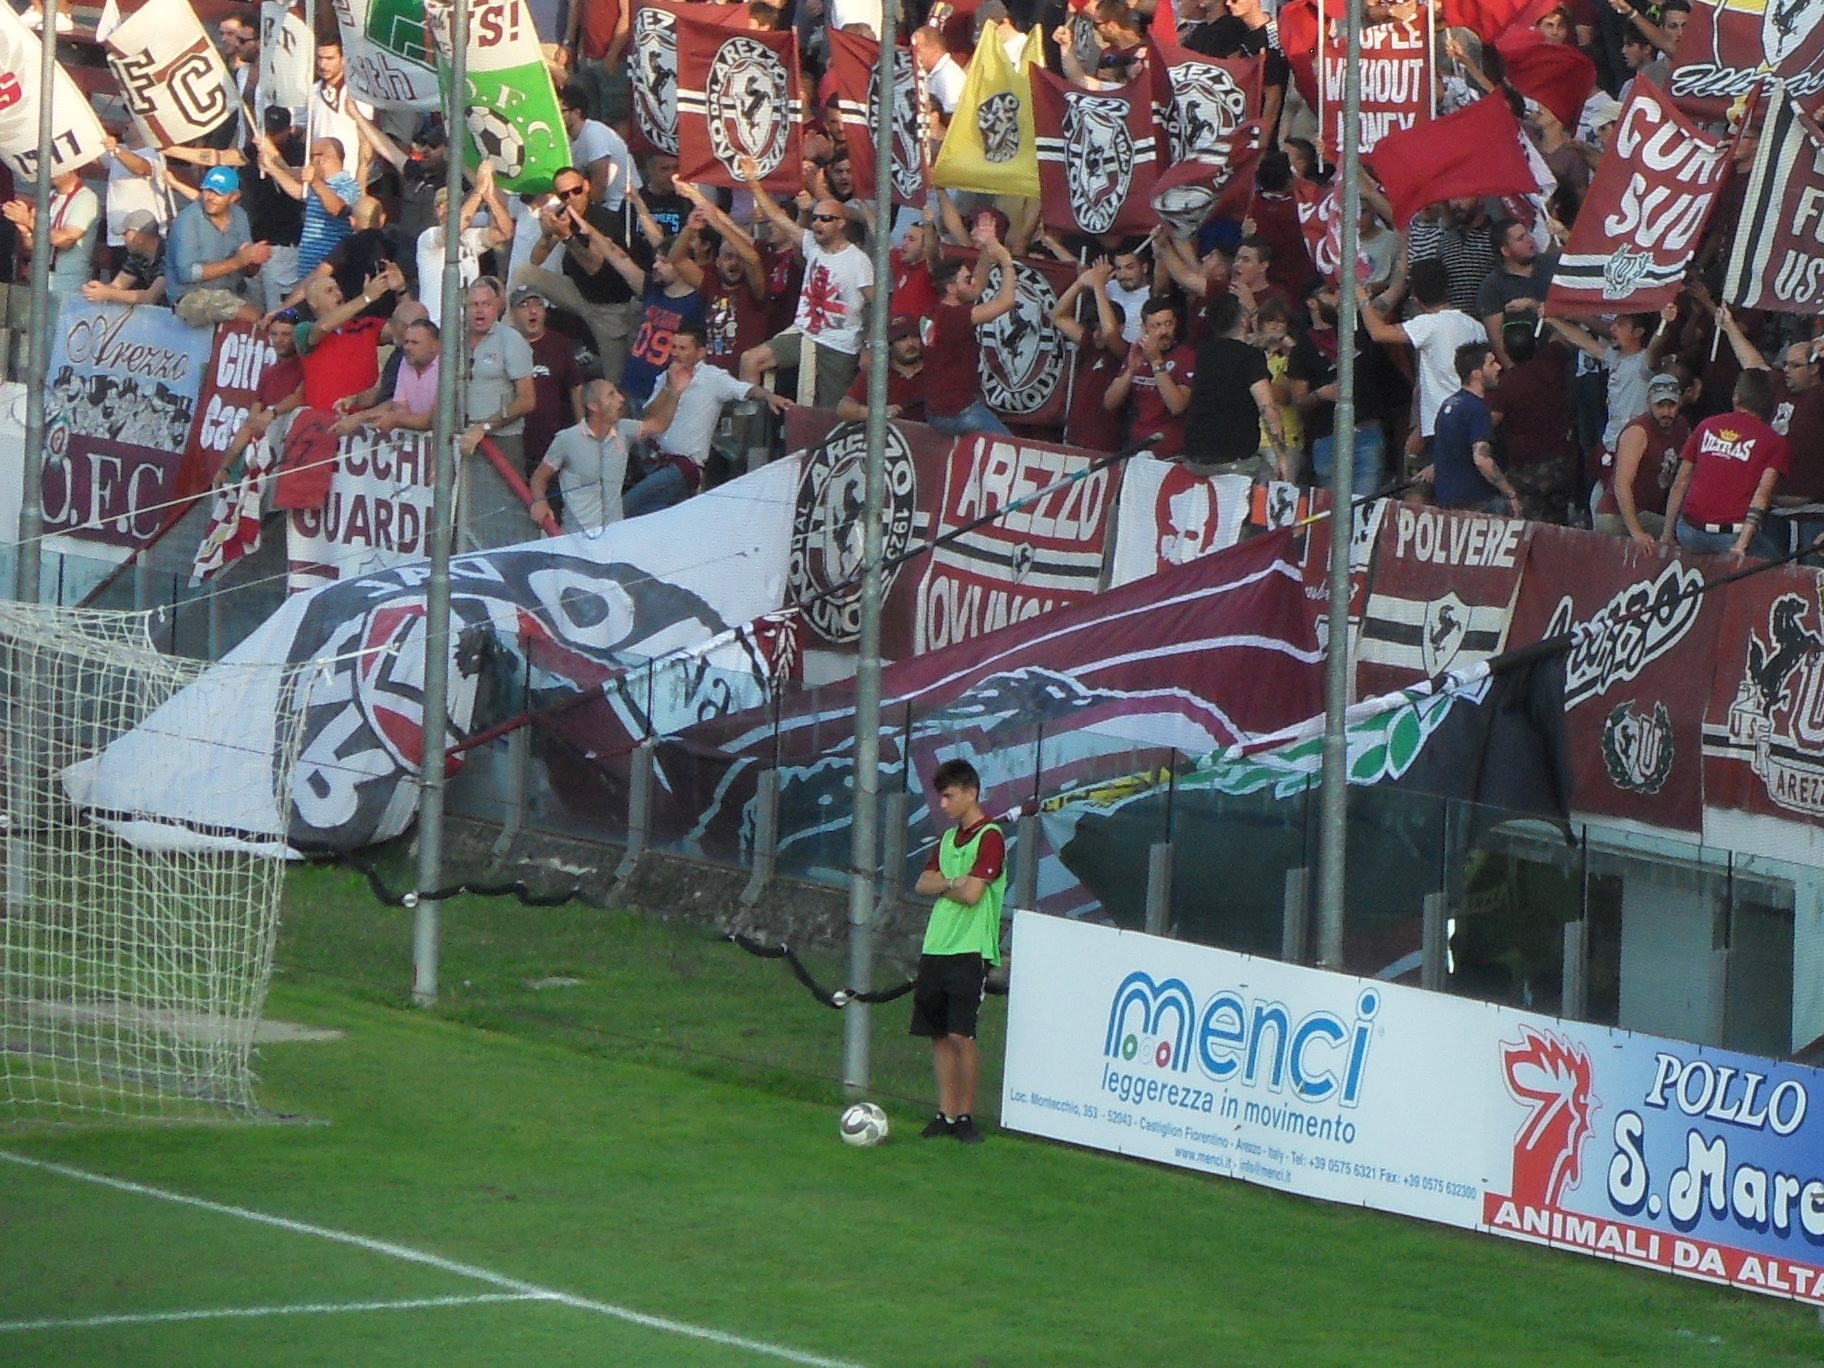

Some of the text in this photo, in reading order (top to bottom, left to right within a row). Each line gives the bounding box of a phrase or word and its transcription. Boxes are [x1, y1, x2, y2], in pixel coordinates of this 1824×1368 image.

[1604, 173, 1714, 251] SUD
[1700, 428, 1757, 463] ULTRAS
[958, 437, 1109, 542] AREZZO
[1395, 507, 1526, 569] POLVERE
[1103, 970, 1381, 1109] menci
[1101, 1062, 1357, 1145] leggerezza in movimento
[1644, 1051, 1808, 1137] POLLO
[1327, 1159, 1352, 1175] 0575
[1494, 1200, 1660, 1261] ANIMALI
[1673, 1240, 1727, 1278] DA
